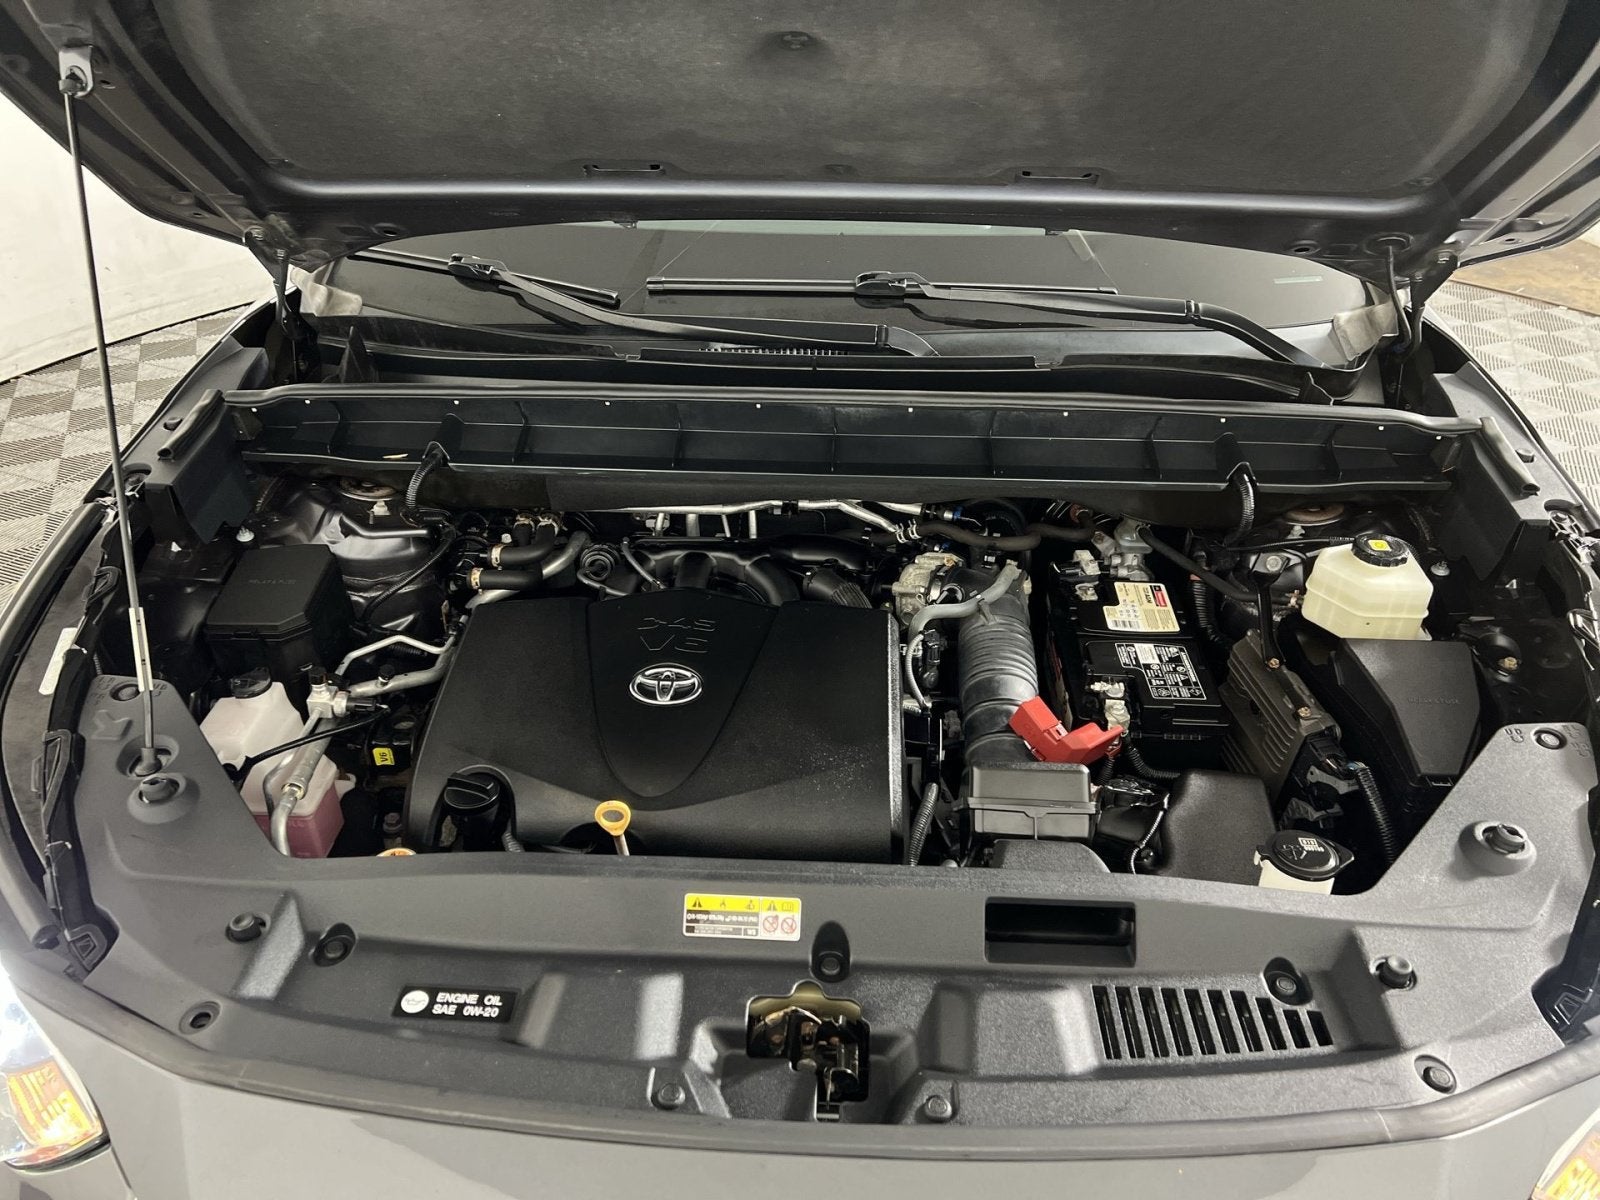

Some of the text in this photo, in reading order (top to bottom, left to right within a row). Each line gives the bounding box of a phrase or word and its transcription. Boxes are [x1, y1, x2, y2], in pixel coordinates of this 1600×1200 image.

[436, 992, 502, 1005] ENGINE OIL
[432, 1004, 499, 1017] SAE 0W-20
